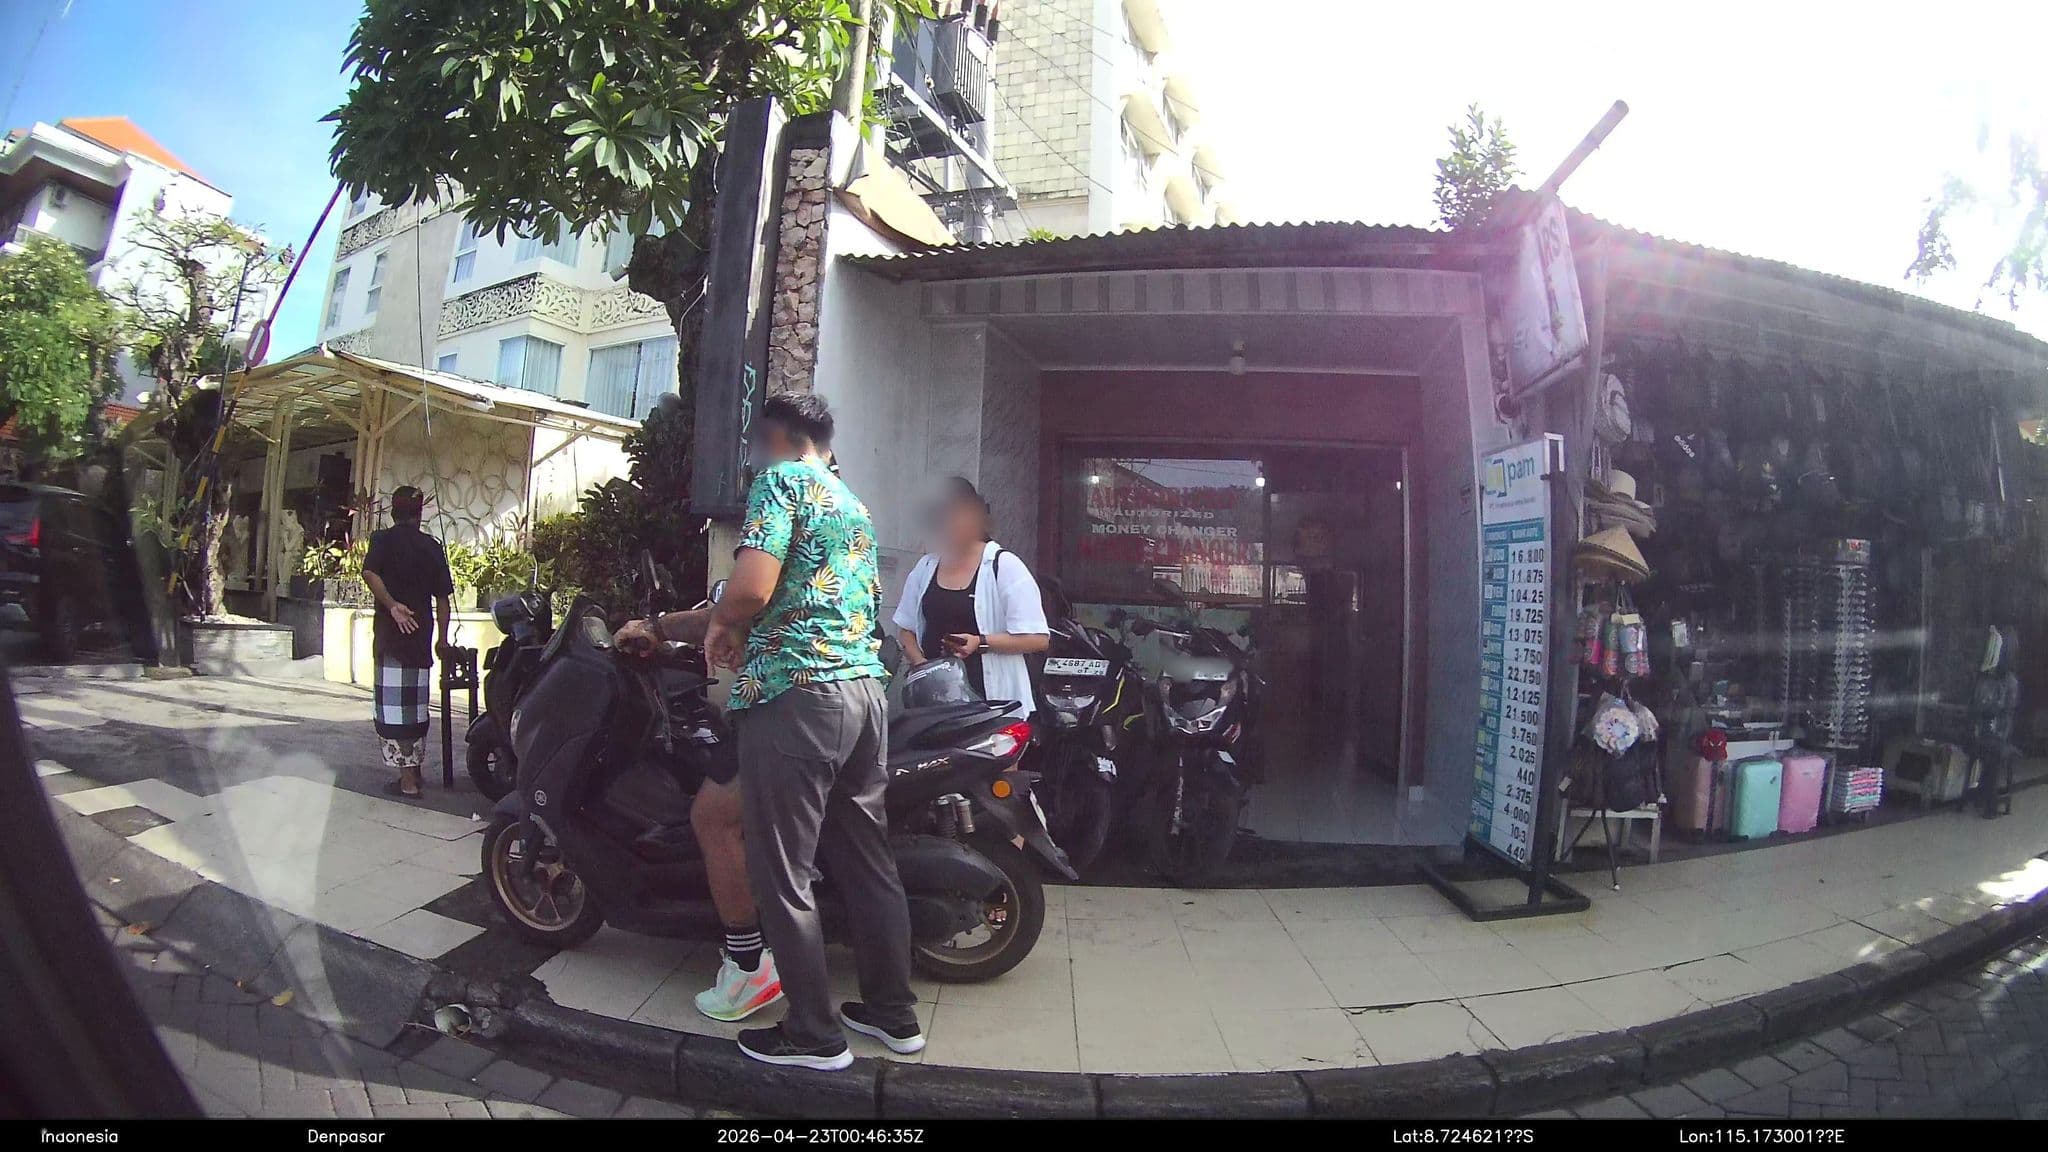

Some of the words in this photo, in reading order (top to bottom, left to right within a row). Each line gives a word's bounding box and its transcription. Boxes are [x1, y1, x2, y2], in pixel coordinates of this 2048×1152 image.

[1507, 456, 1535, 488] pam
[1091, 523, 1151, 535] MONEY
[1156, 524, 1239, 538] CHANGER
[1510, 608, 1543, 623] 19.725
